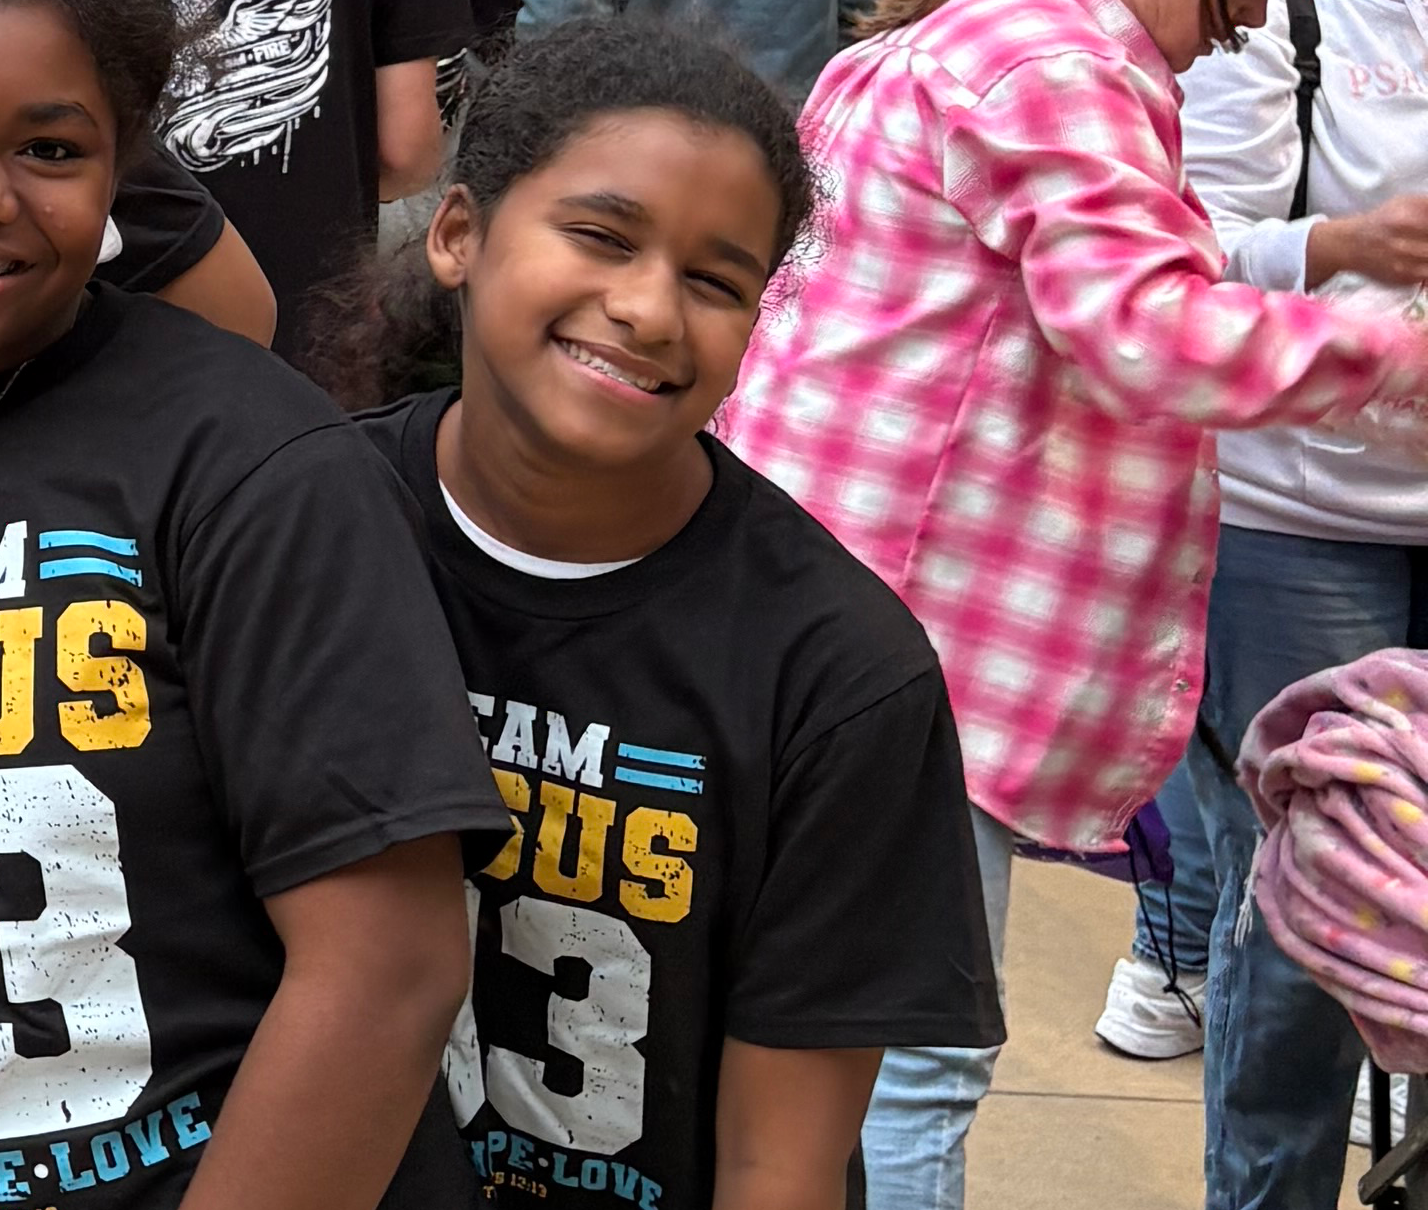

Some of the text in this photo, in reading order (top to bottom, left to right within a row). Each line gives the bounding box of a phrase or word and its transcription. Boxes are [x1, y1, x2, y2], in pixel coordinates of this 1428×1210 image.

[253, 39, 292, 62] FIRE
[466, 690, 611, 788] EAM
[477, 767, 698, 923] SUS
